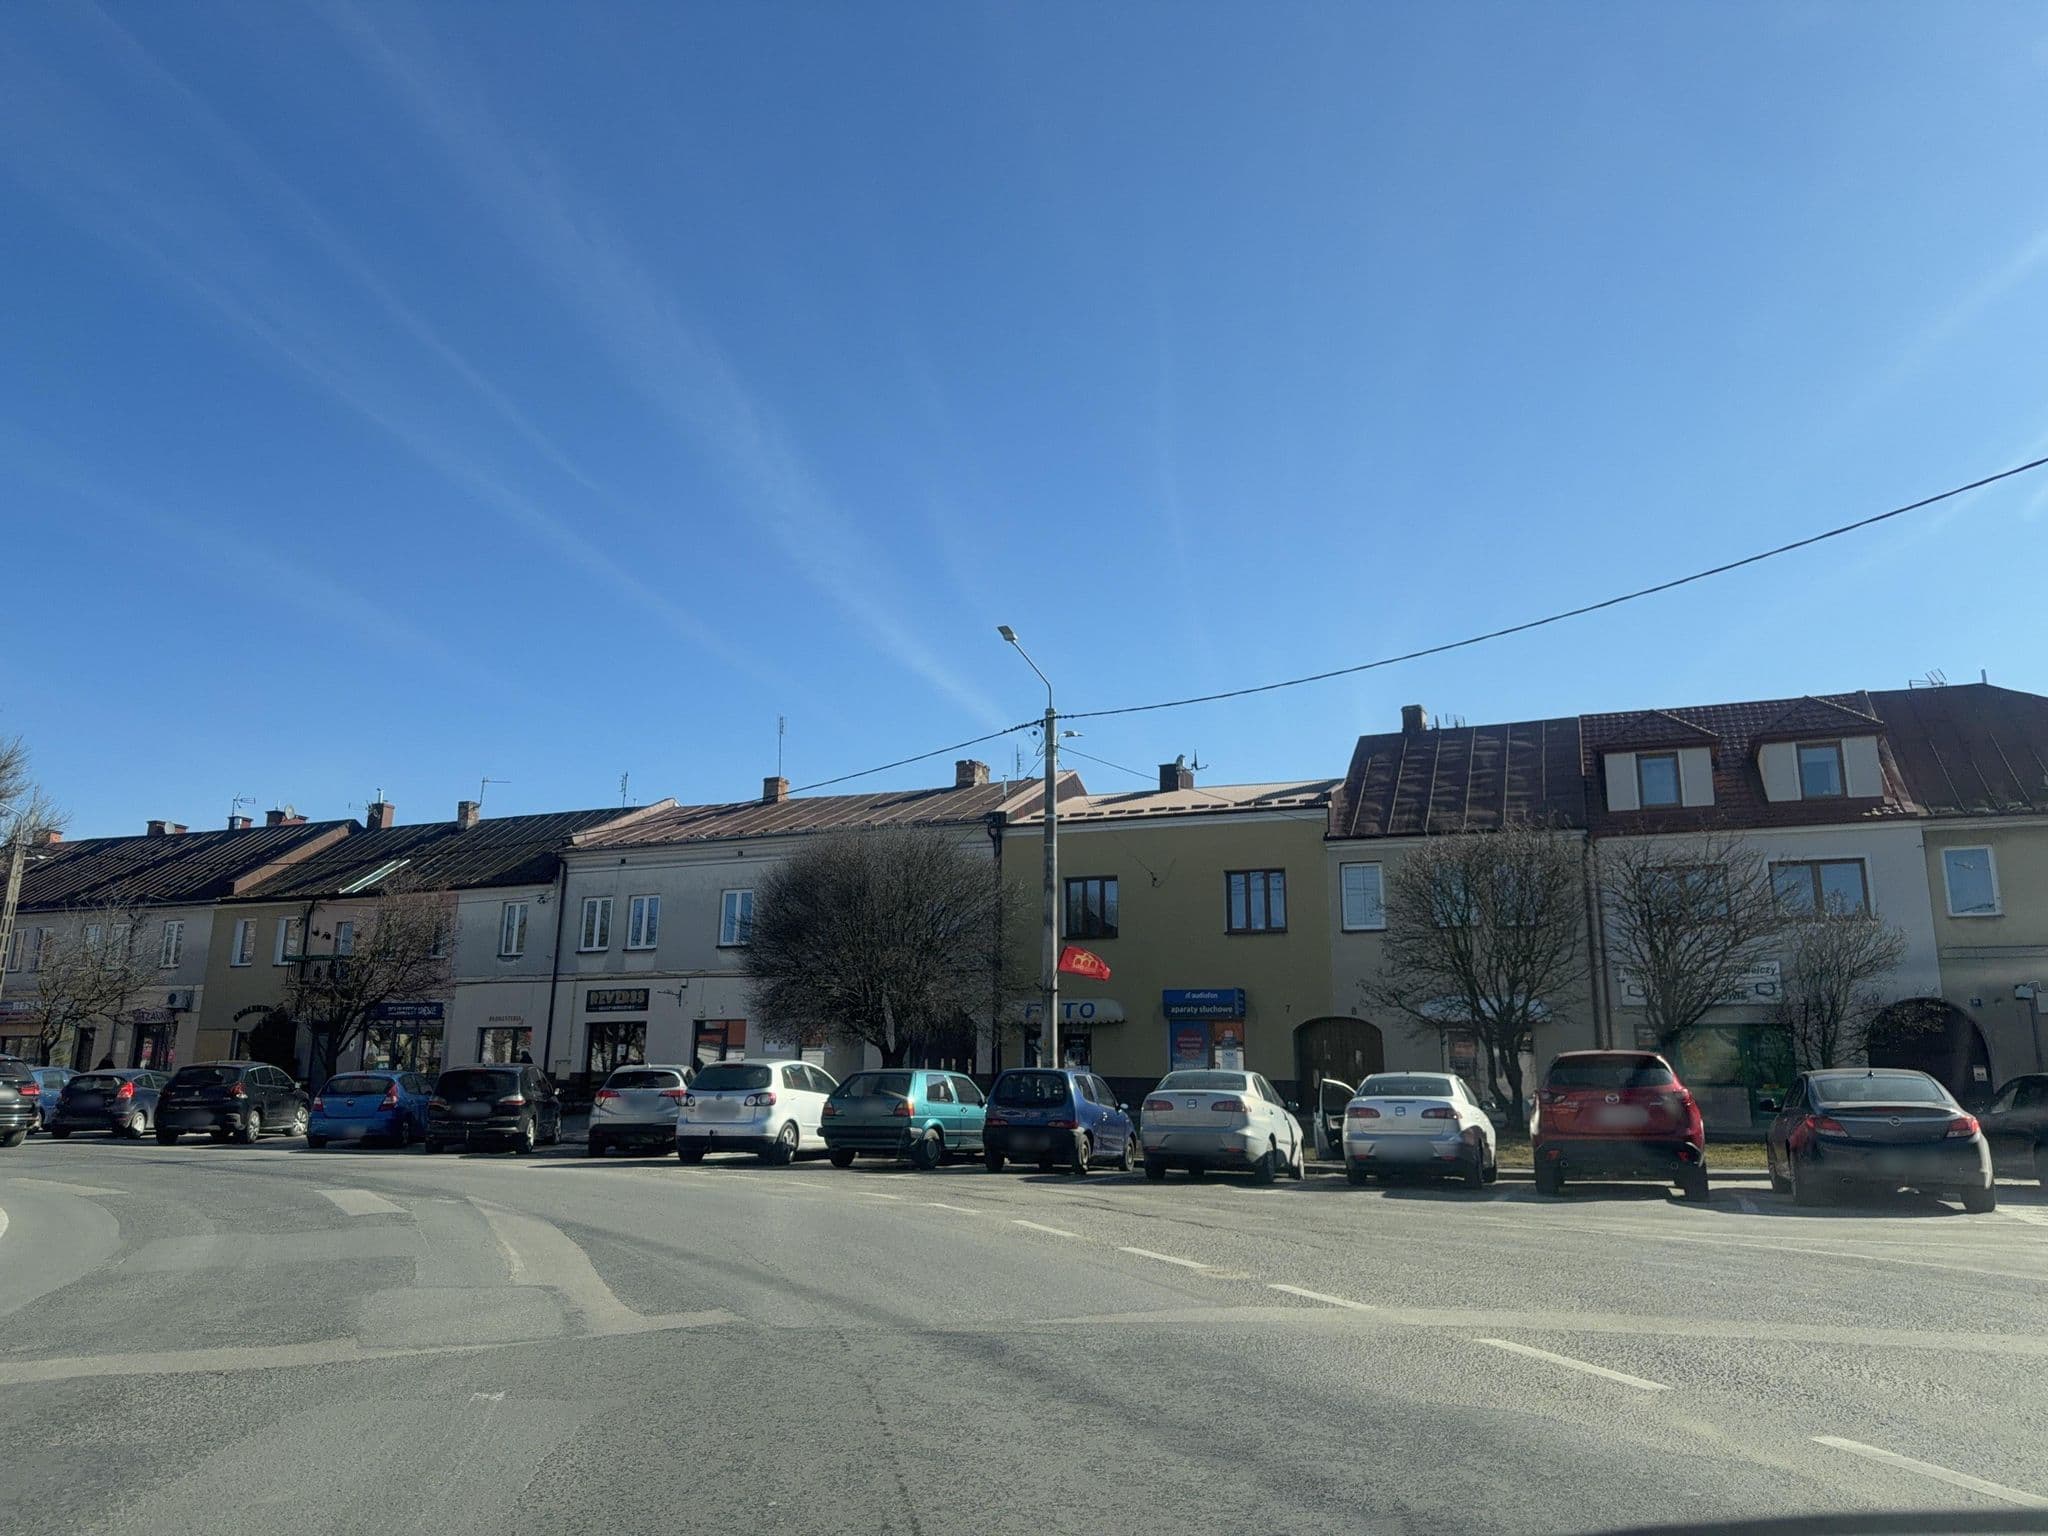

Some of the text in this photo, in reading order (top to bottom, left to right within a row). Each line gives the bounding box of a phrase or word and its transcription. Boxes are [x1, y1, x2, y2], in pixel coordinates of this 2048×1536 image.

[1191, 991, 1218, 999] audiofon
[1025, 1002, 1095, 1018] FTO
[1199, 1005, 1233, 1013] słuchowe
